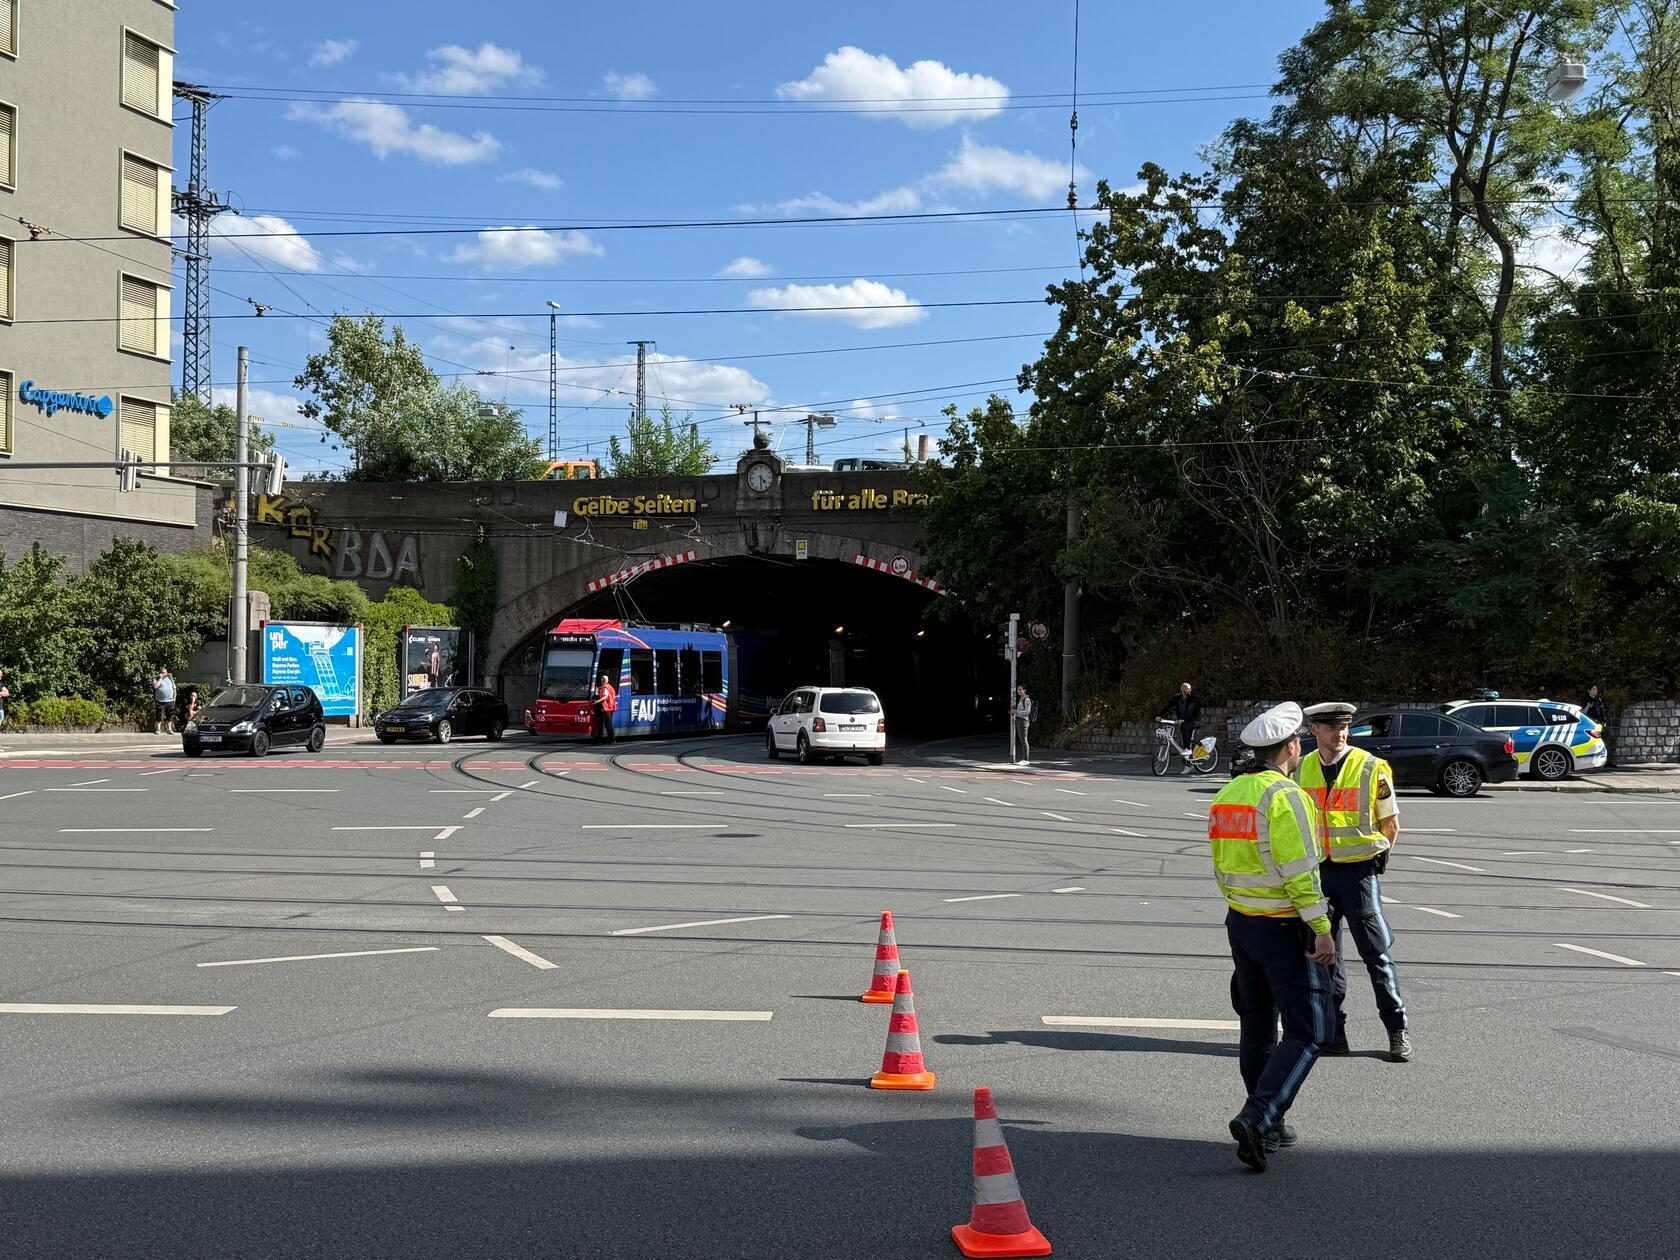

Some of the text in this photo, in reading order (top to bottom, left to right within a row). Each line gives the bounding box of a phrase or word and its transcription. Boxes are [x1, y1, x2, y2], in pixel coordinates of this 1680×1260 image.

[19, 379, 98, 415] Capgemini
[573, 495, 629, 515] Gelbe
[634, 493, 697, 514] Seiten
[811, 489, 845, 510] für
[848, 488, 888, 509] alle
[269, 629, 284, 641] uni
[272, 640, 288, 652] per
[630, 698, 657, 722] FAU
